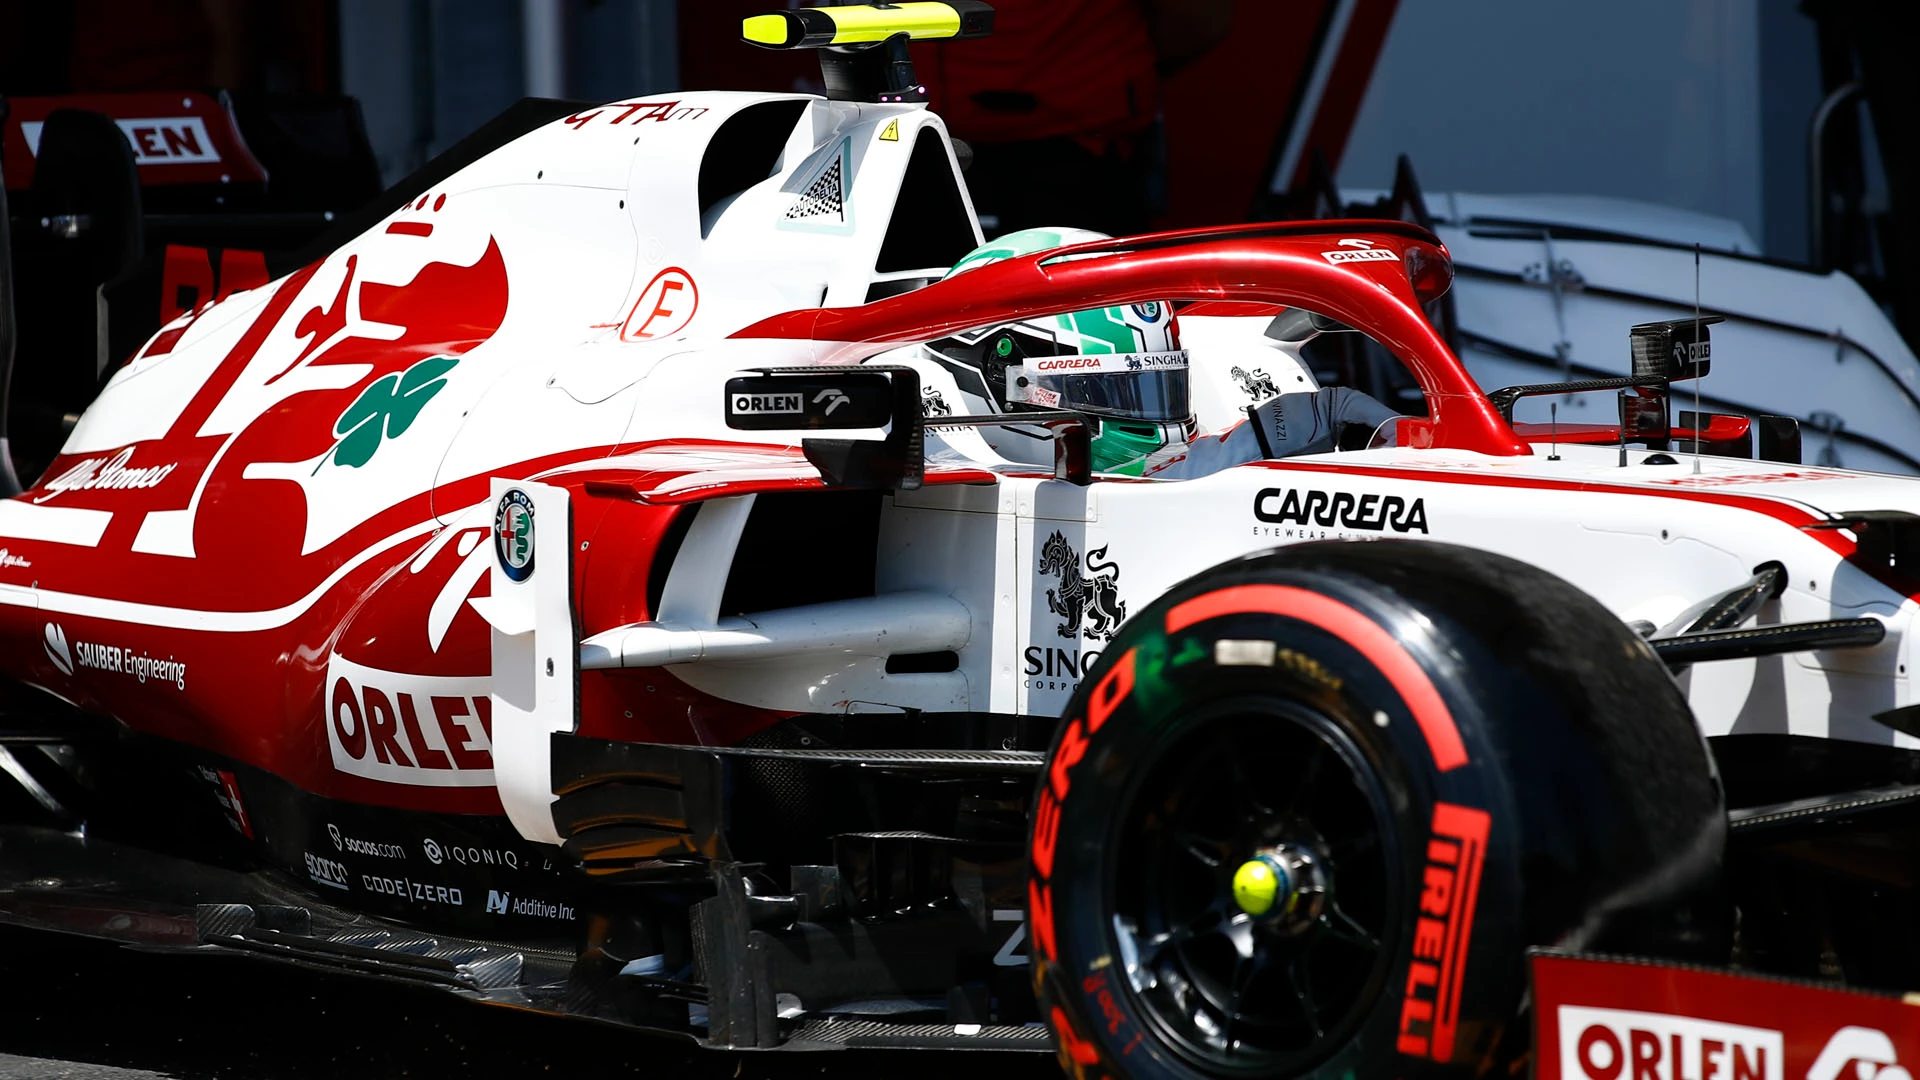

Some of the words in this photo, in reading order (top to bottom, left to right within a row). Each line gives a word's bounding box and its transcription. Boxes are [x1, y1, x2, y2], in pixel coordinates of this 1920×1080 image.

[132, 126, 204, 158] EN
[794, 182, 838, 214] AUTODELTA
[1330, 251, 1392, 261] ORLEN
[632, 280, 684, 338] E
[1037, 358, 1101, 370] CARRERA
[1144, 355, 1182, 367] SINGHA
[736, 396, 799, 412] ORLEN
[495, 496, 510, 534] ALFA
[1253, 487, 1429, 534] CARRERA
[1253, 526, 1326, 540] EYEWEAR
[76, 641, 122, 673] SAUBER
[124, 649, 186, 691] Engineering
[1028, 646, 1138, 963] ZERO
[345, 837, 406, 859] socios.com
[444, 845, 518, 870] IQONIQ
[513, 897, 557, 919] Additive
[1397, 802, 1492, 1064] PIRELLI
